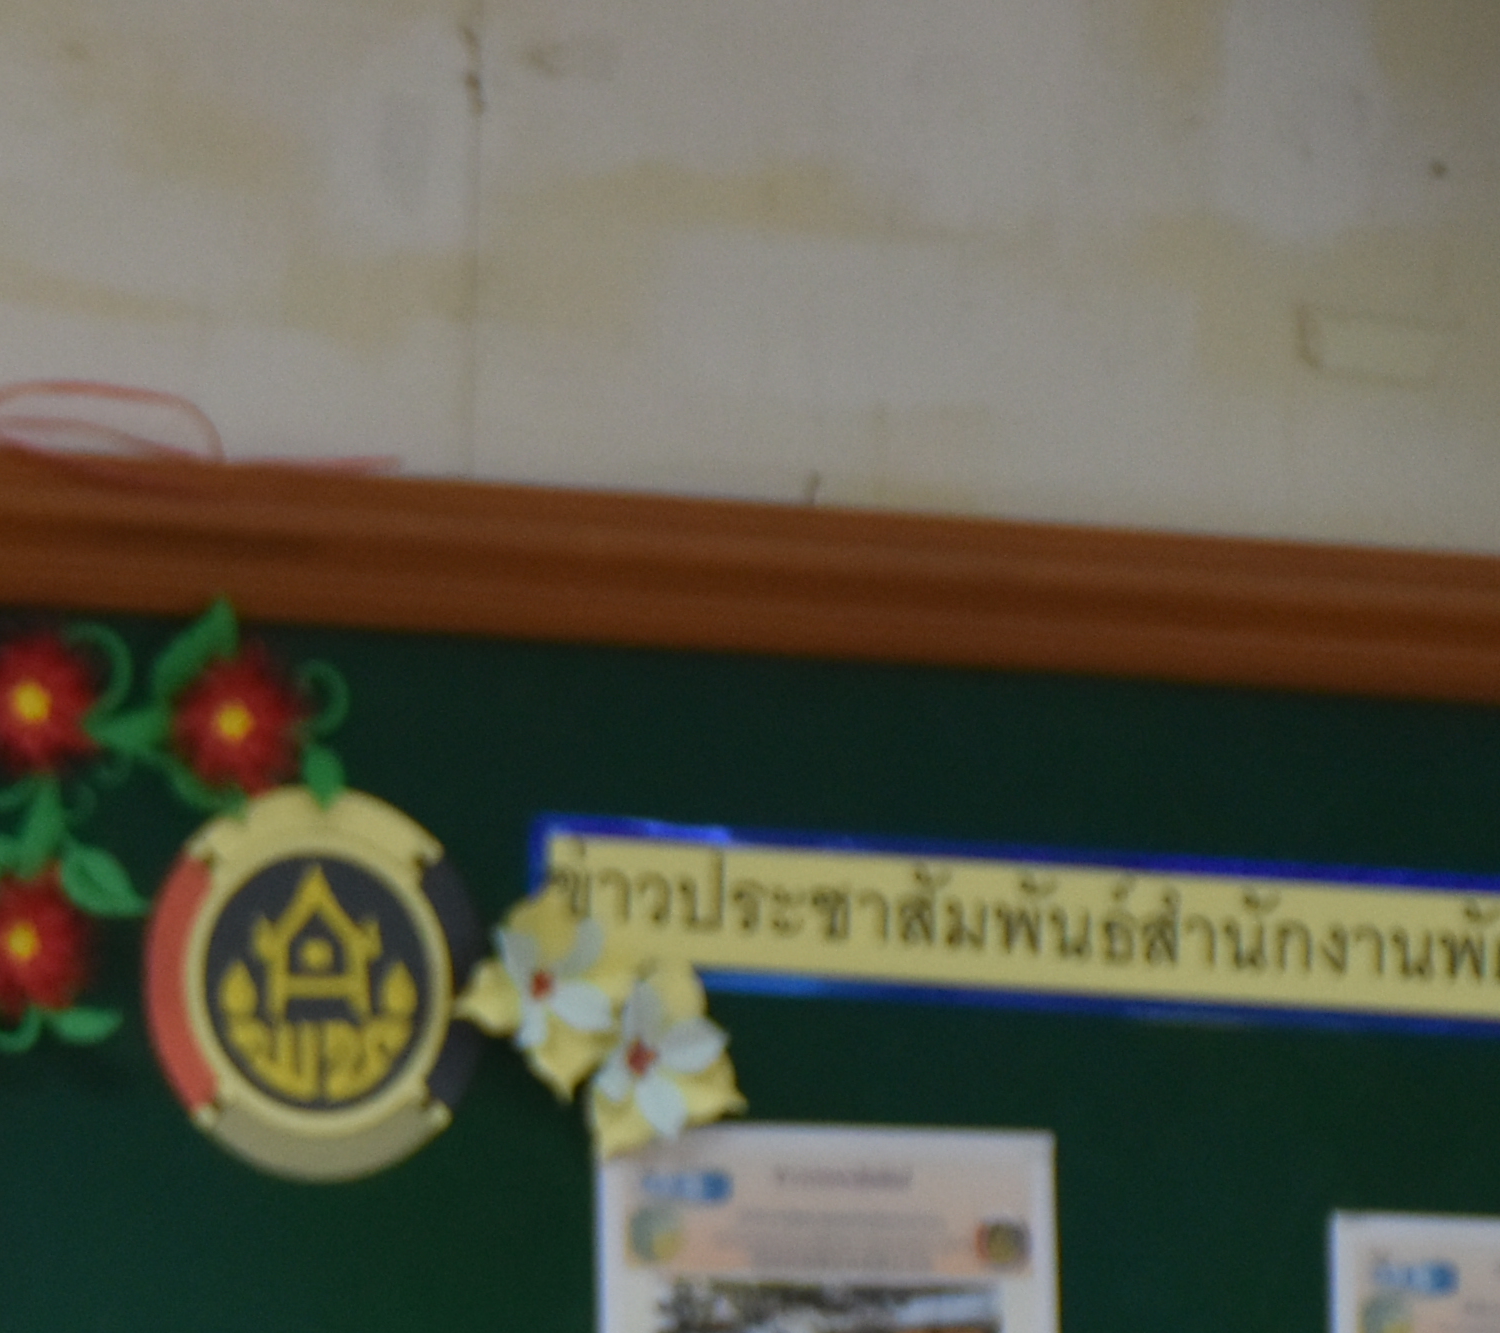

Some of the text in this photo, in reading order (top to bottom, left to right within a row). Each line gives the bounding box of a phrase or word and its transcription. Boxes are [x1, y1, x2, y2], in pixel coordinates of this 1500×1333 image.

[548, 837, 1500, 983] ข่าวประชาสัมพันธ์สำนักงานพั
